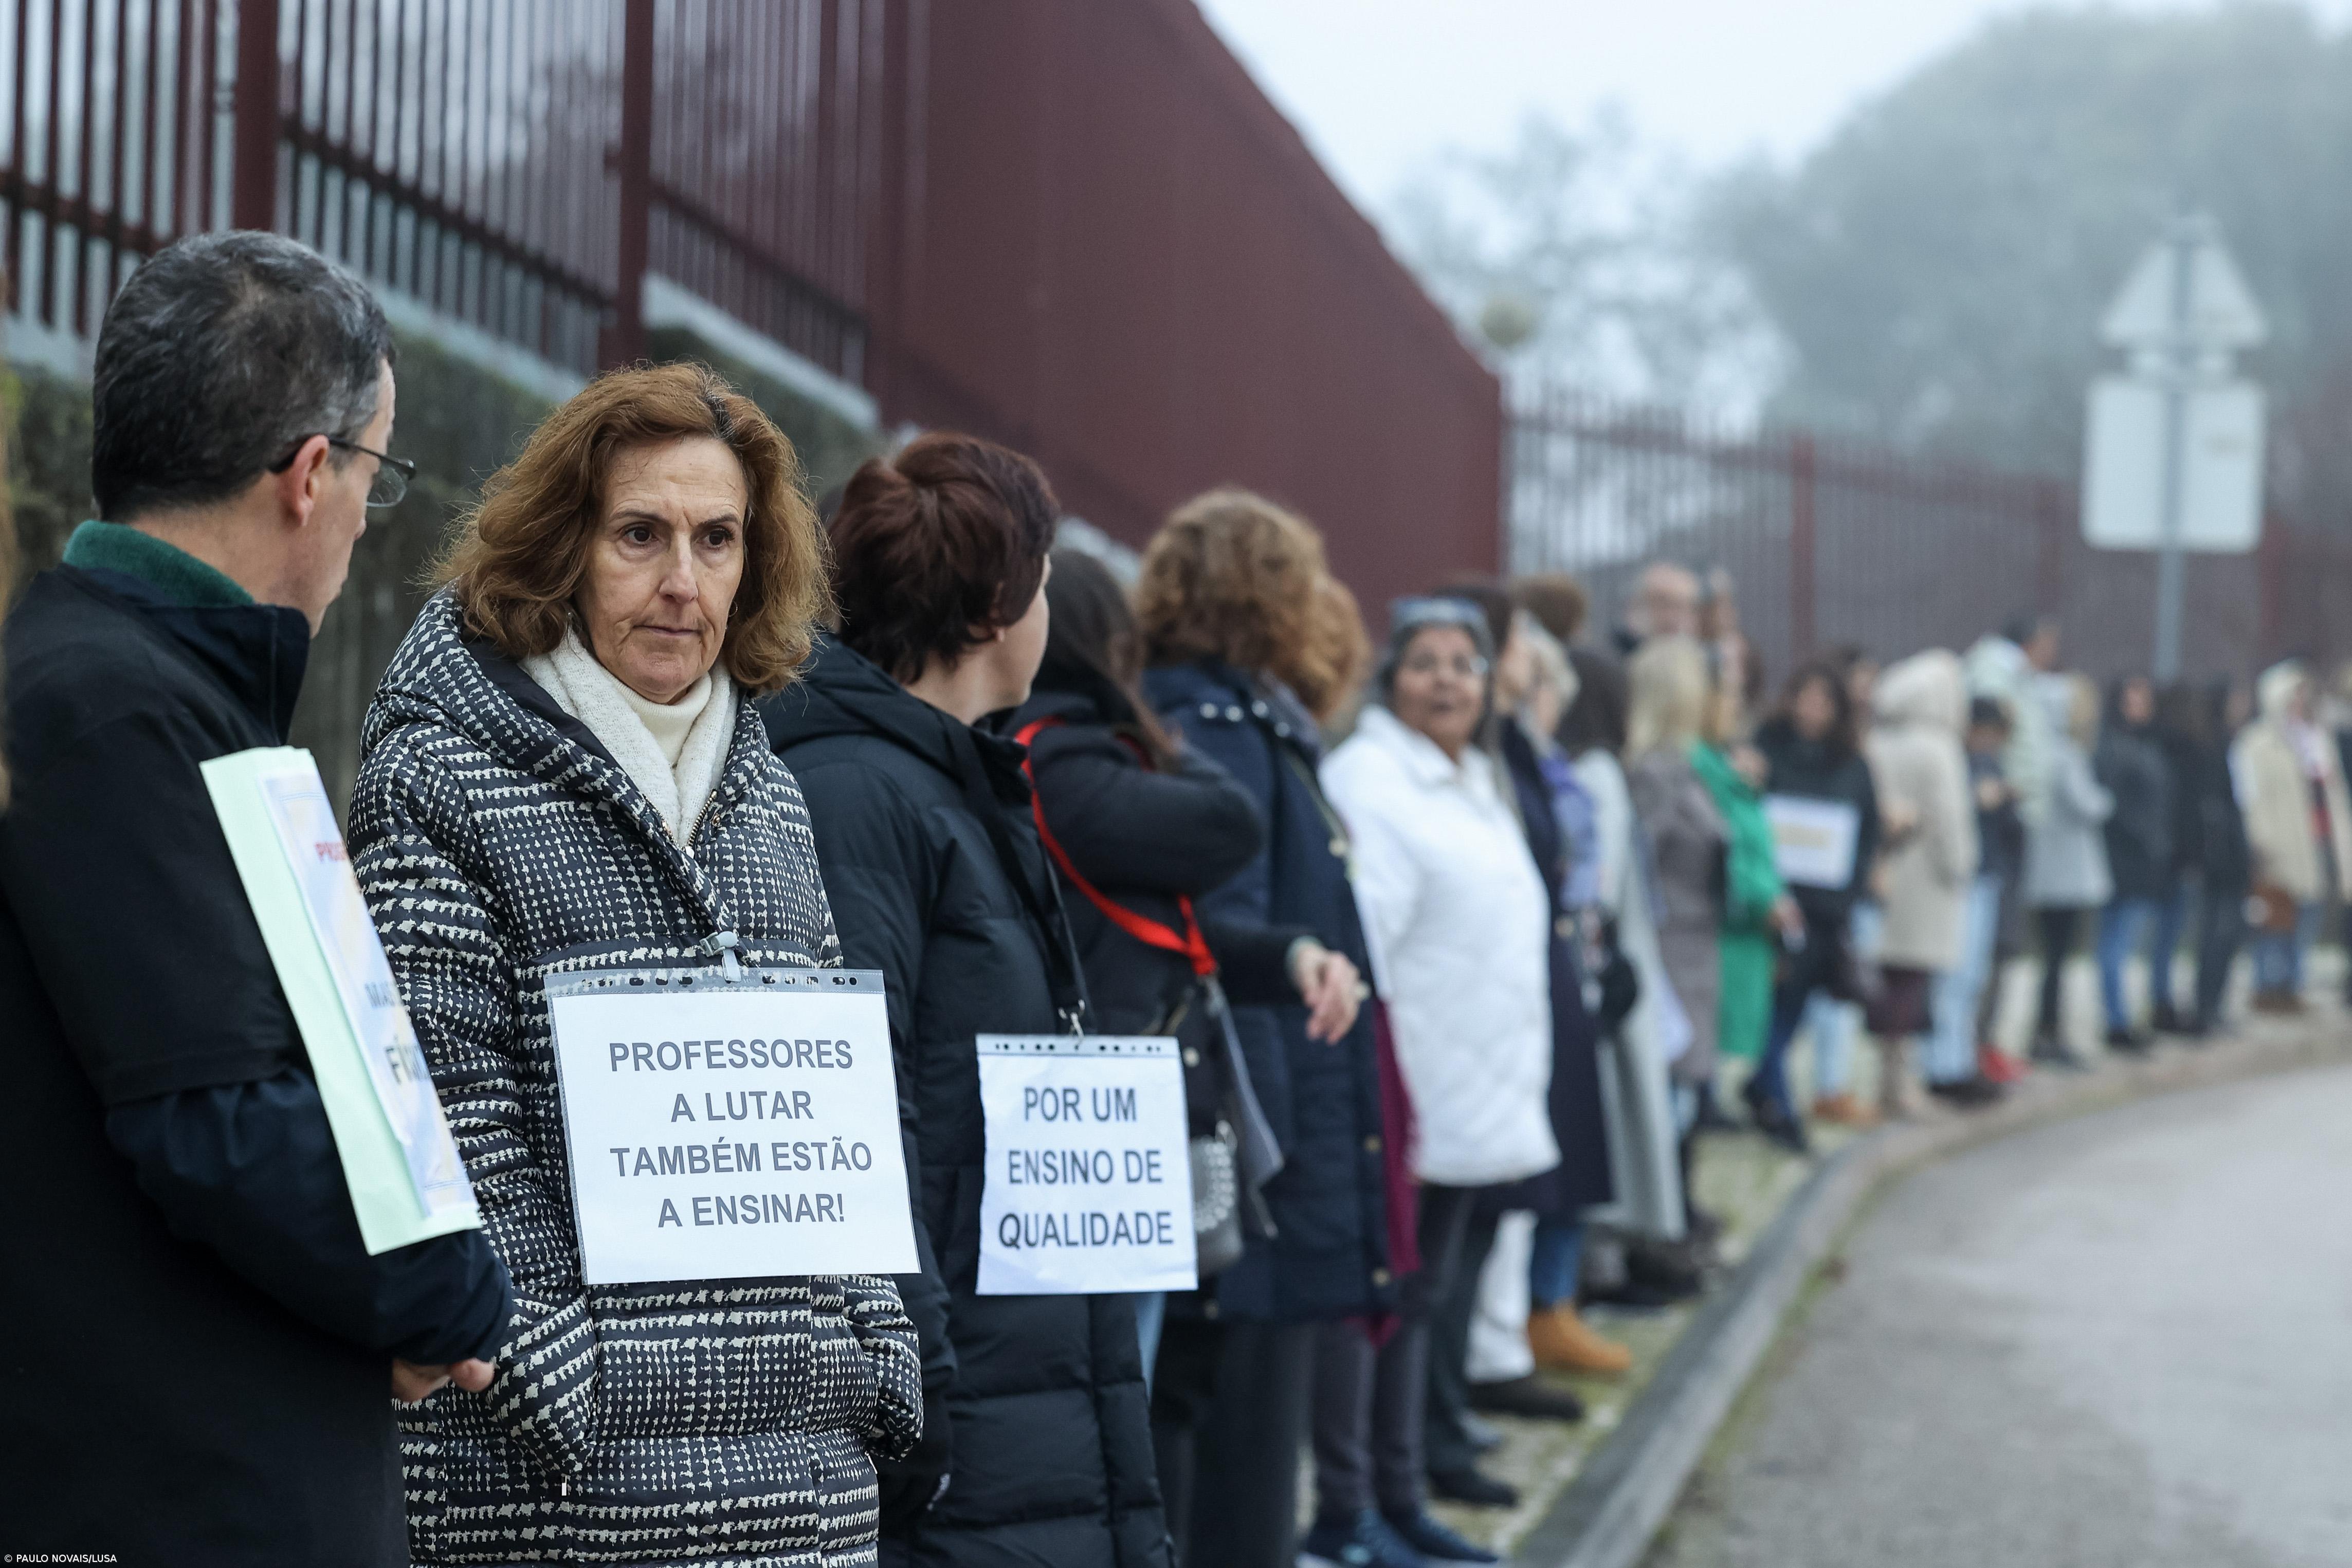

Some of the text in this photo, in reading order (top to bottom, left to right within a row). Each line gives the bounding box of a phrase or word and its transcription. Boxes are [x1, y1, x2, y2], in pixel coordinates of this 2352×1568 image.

[609, 1038, 853, 1072] PROFESSORES
[670, 1090, 815, 1123] A LUTAR
[1024, 1086, 1137, 1123] POR UM
[609, 1135, 872, 1177] TAMBÉM ESTÃO
[1007, 1148, 1163, 1186] ENSINO DE
[657, 1193, 845, 1228] A ENSINAR!
[997, 1210, 1175, 1251] QUALIDADE
